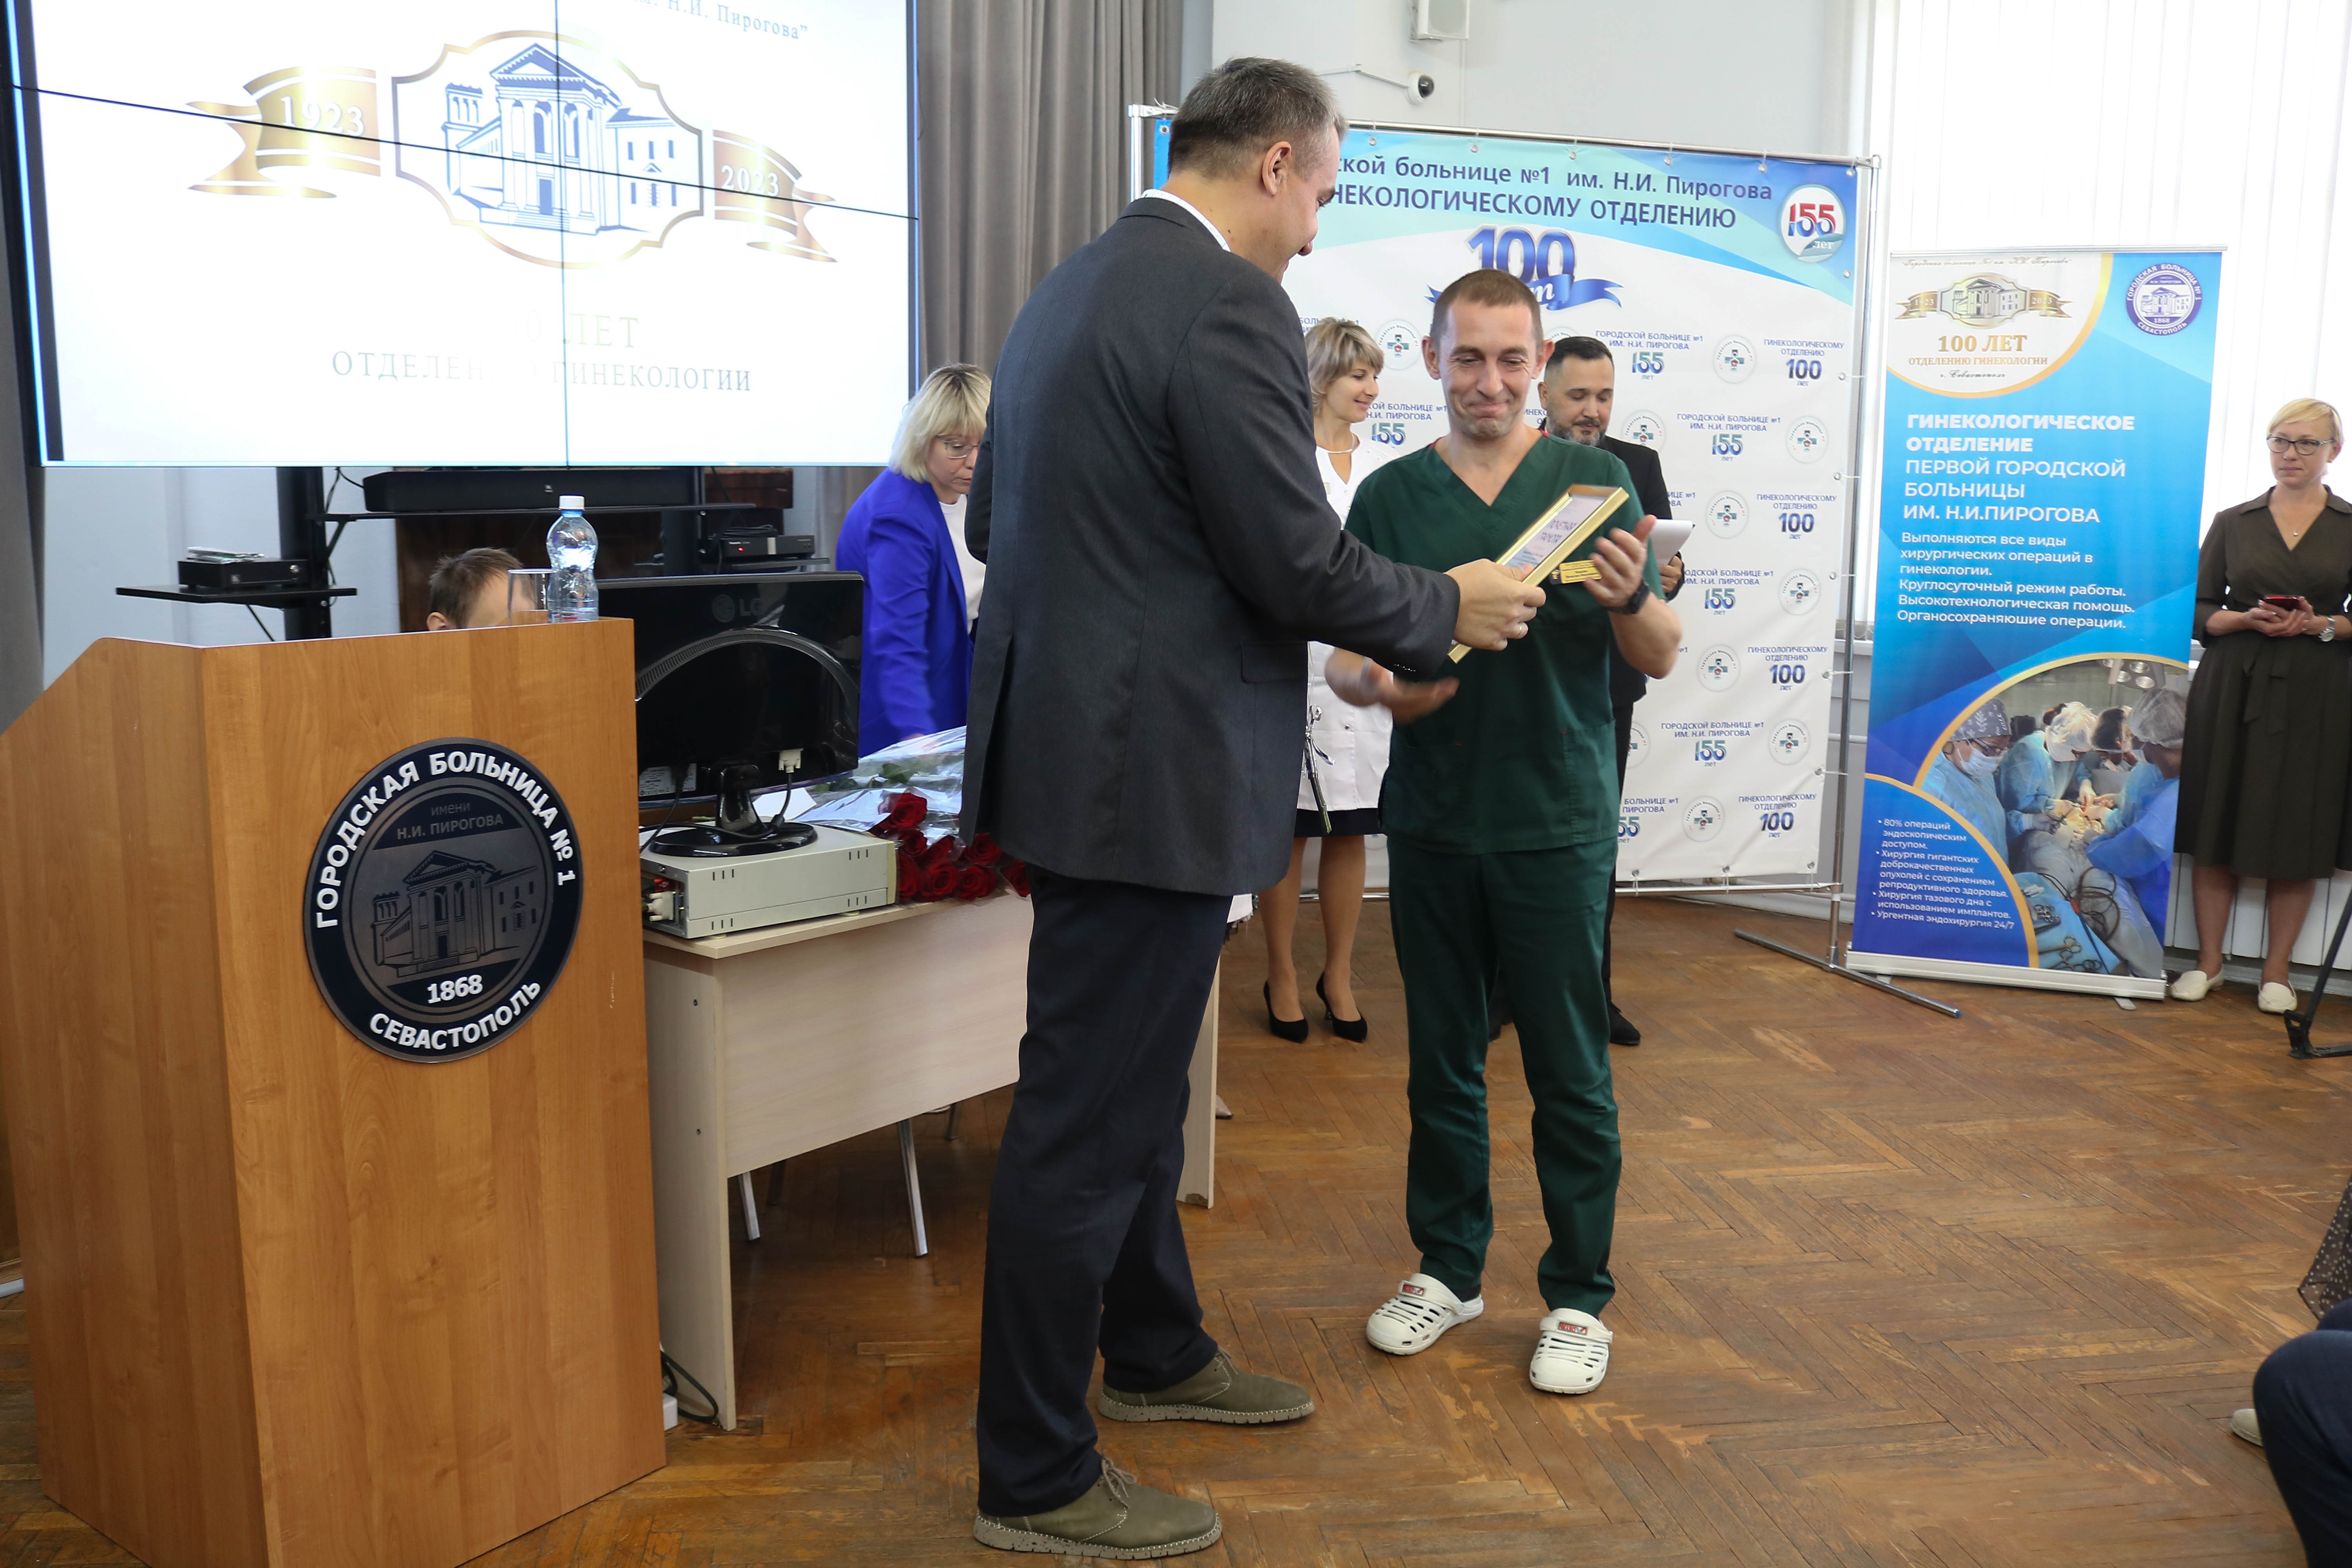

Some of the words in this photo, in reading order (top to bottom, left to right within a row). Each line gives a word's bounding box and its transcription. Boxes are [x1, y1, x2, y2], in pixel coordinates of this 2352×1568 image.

[281, 96, 365, 136] 1923
[721, 165, 779, 196] 2023
[1396, 156, 1511, 184] больнице
[1521, 167, 1549, 184] №1
[1568, 172, 1602, 188] им.
[1615, 172, 1656, 192] Н.И.
[1667, 176, 1772, 200] Пирогова
[1335, 184, 1581, 217] НЕКОЛОГИЧЕСКОМУ
[1591, 200, 1736, 228] ОТДЕЛЕНИЮ
[1788, 203, 1836, 237] 155
[2127, 266, 2157, 301] ГОРОДСКАЯ
[2161, 264, 2198, 285] БОЛЬНИЦА
[1596, 330, 1645, 339] ГОРОДСКОЙ
[1648, 333, 1691, 342] БОЛЬНИЦЕ
[2138, 321, 2187, 334] СЕВАСТОПОЛЬ
[1938, 336, 1977, 352] 100
[1982, 335, 2027, 351] ЛЕТ
[1632, 352, 1664, 374] 155
[1786, 359, 1822, 379] 100
[1909, 357, 1971, 366] ОТДЕЛЕНИЮ
[1973, 357, 2048, 365] ГИНЕКОЛОГИИ
[332, 351, 537, 383] ОТДЕЛЕН
[552, 361, 751, 392] ГИНЕКОЛОГИИ
[1388, 403, 1433, 412] БОЛЬНИЦЕ
[1677, 414, 1724, 422] ГОРОДСКОЙ
[1907, 414, 2134, 430] ГИНЕКОЛОГИЧЕСКОЕ
[1372, 423, 1405, 445] 155
[1712, 434, 1742, 455] 155
[1906, 437, 2033, 453] ОТДЕЛЕНИЕ
[1906, 457, 1989, 474] ПЕРВОЙ
[1996, 459, 2125, 478] ГОРОДСКОЙ
[1904, 482, 2024, 500] БОЛЬНИЦЫ
[1779, 513, 1815, 533] 100
[1904, 505, 1940, 519] ИМ.
[1946, 505, 2100, 523] Н.И.ПИРОГОВА
[1902, 532, 1996, 544] Выполняются
[2001, 537, 2025, 545] все
[2029, 537, 2066, 547] виды
[1900, 549, 2005, 561] хирургических
[2009, 552, 2080, 564] операций
[2085, 554, 2093, 563] в
[1900, 565, 1992, 575] гинекологии.
[1899, 579, 2013, 592] Круглосуточный
[2016, 583, 2065, 595] режим
[2070, 584, 2126, 597] работы.
[1705, 588, 1735, 609] 155
[1899, 595, 2069, 610] Высокотехнологическая
[2073, 603, 2135, 613] помощь.
[2050, 617, 2126, 628] операции.
[1769, 665, 1805, 684] 100
[1695, 740, 1725, 761] 155
[428, 751, 559, 829] БОЛЬНИЦА
[430, 802, 470, 817] имени
[397, 826, 426, 839] Н.И.
[430, 813, 504, 835] ПИРОГОВА
[1617, 817, 1640, 837] 55
[1760, 813, 1794, 831] 100
[1884, 819, 1902, 827] 80%
[1904, 821, 1951, 830] операций
[316, 761, 420, 929] ГОРОДСКАЯ
[1882, 841, 1928, 849] доступом.
[1883, 831, 1967, 841] эндоскопическим
[550, 829, 573, 862] №
[1882, 850, 1925, 859] Хирургия
[1927, 854, 1979, 863] гигантских
[1880, 860, 1974, 873] доброкачественных
[557, 869, 576, 886] 1
[1880, 871, 1922, 880] опухолей
[1932, 877, 1995, 886] сохранением
[1878, 891, 1922, 900] Хирургия
[1924, 895, 1965, 904] тазового
[1879, 881, 1960, 893] репродуктивного
[1962, 889, 2008, 898] здоровья.
[1878, 902, 1955, 914] использованием
[1958, 909, 2011, 919] имплантов.
[1877, 911, 1924, 921] Ургентная
[1926, 916, 1992, 927] эндохирургия
[1994, 921, 2014, 929] 24/7
[427, 975, 483, 1004] 1868
[369, 980, 541, 1051] СЕВАСТОПОЛЬ
